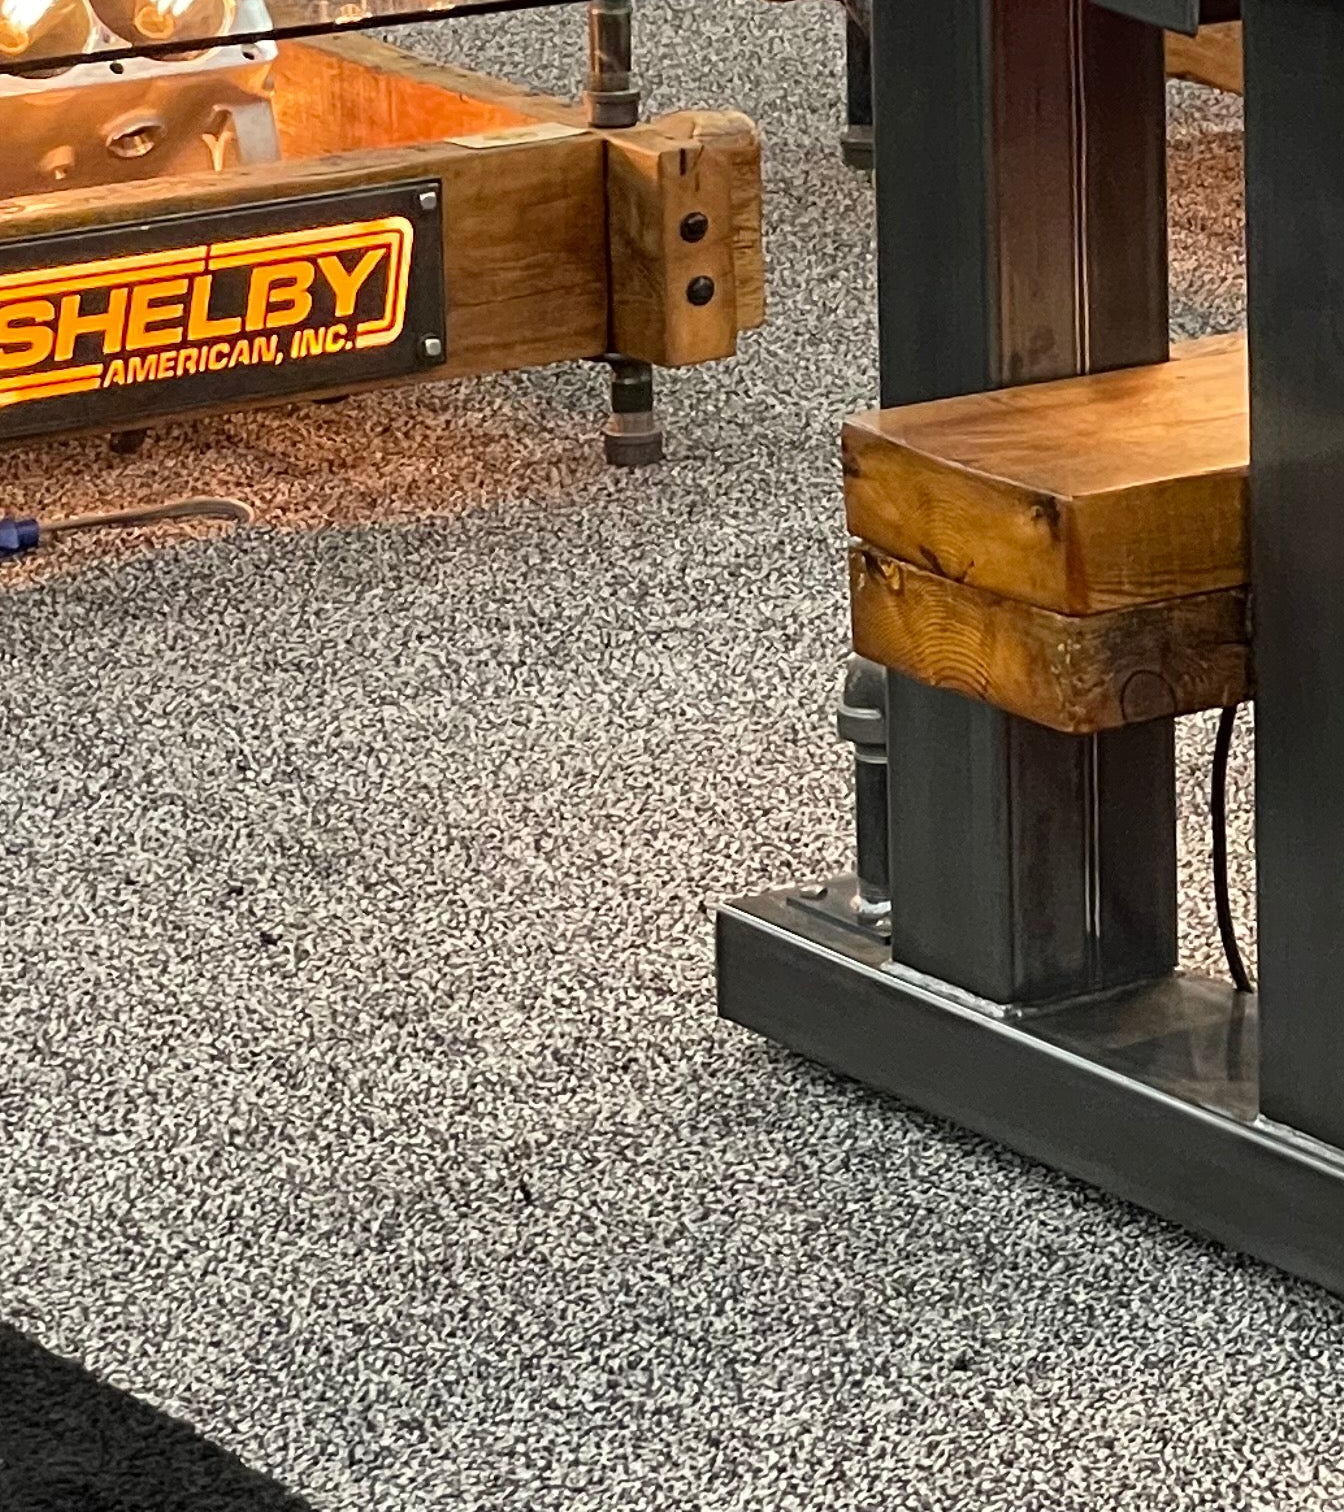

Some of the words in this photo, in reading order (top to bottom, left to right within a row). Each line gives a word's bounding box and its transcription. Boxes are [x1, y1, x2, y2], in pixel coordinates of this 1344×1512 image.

[0, 248, 388, 369] SHELBY
[103, 334, 285, 388] AMERICAN,
[290, 324, 354, 360] INC.
